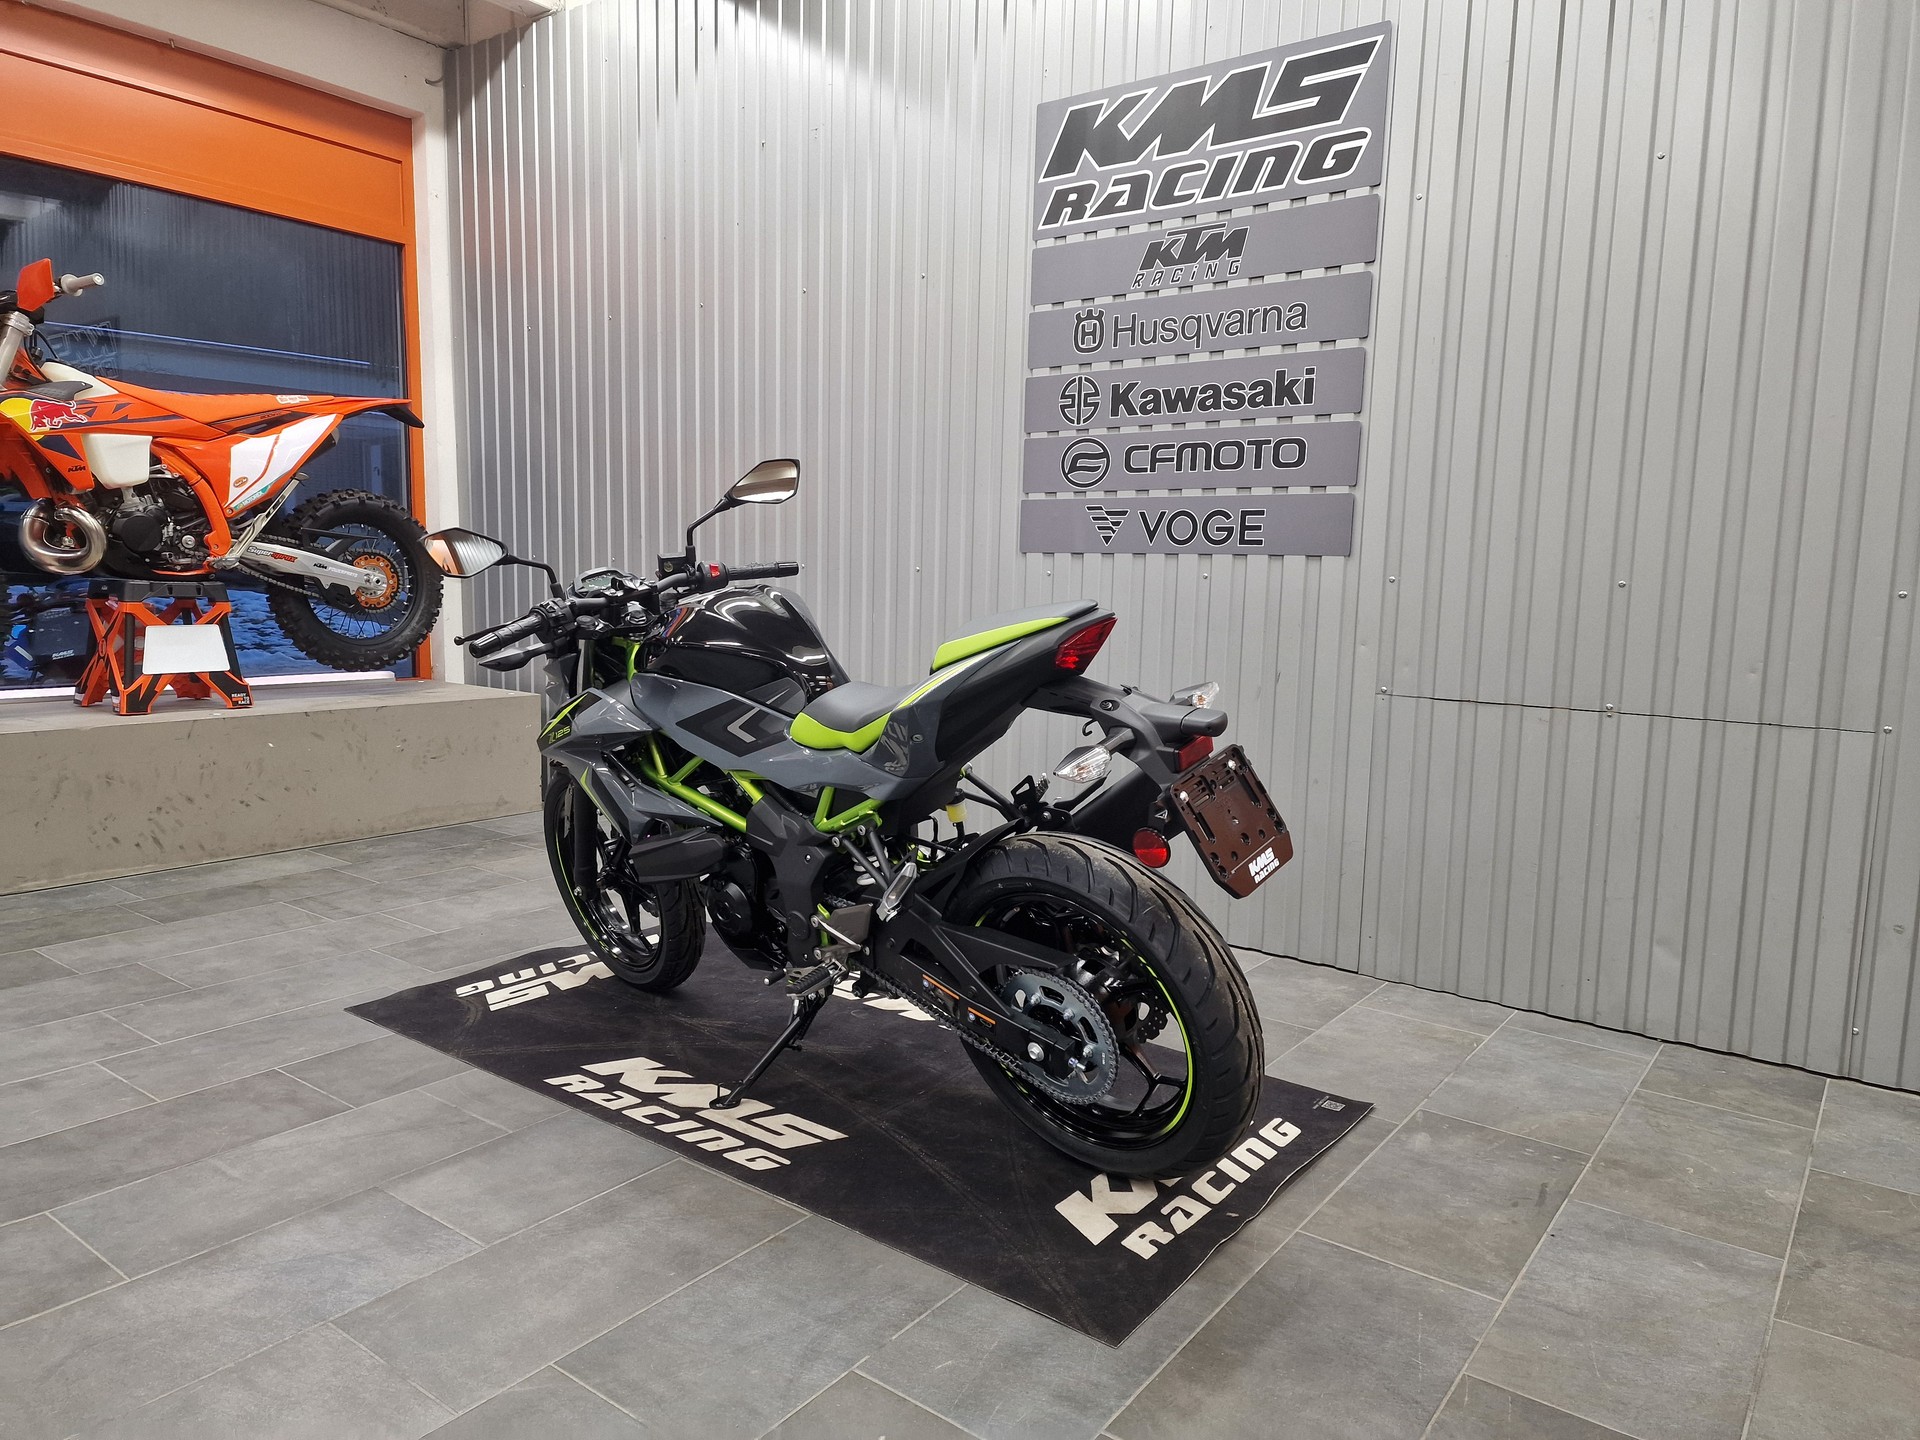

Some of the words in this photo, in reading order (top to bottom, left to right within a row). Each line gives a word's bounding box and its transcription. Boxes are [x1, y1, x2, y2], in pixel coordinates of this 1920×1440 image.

[1038, 34, 1385, 183] KMS
[1037, 127, 1372, 230] RACING
[1138, 222, 1250, 272] KTM
[1131, 258, 1241, 290] RACING
[1112, 301, 1309, 350] Husqvarna
[1109, 366, 1317, 418] Kawasaki
[67, 464, 86, 473] KTM
[1124, 436, 1308, 474] CFMOTO
[1138, 508, 1266, 546] VOGE
[313, 562, 328, 570] KTM
[548, 726, 570, 744] Z125
[1249, 847, 1275, 876] KMS
[1254, 858, 1280, 883] RACING
[456, 952, 592, 998] CING
[485, 962, 616, 1012] MS
[543, 1074, 792, 1171] RACING
[580, 1057, 849, 1150] KMS
[1121, 1118, 1301, 1260] RACING
